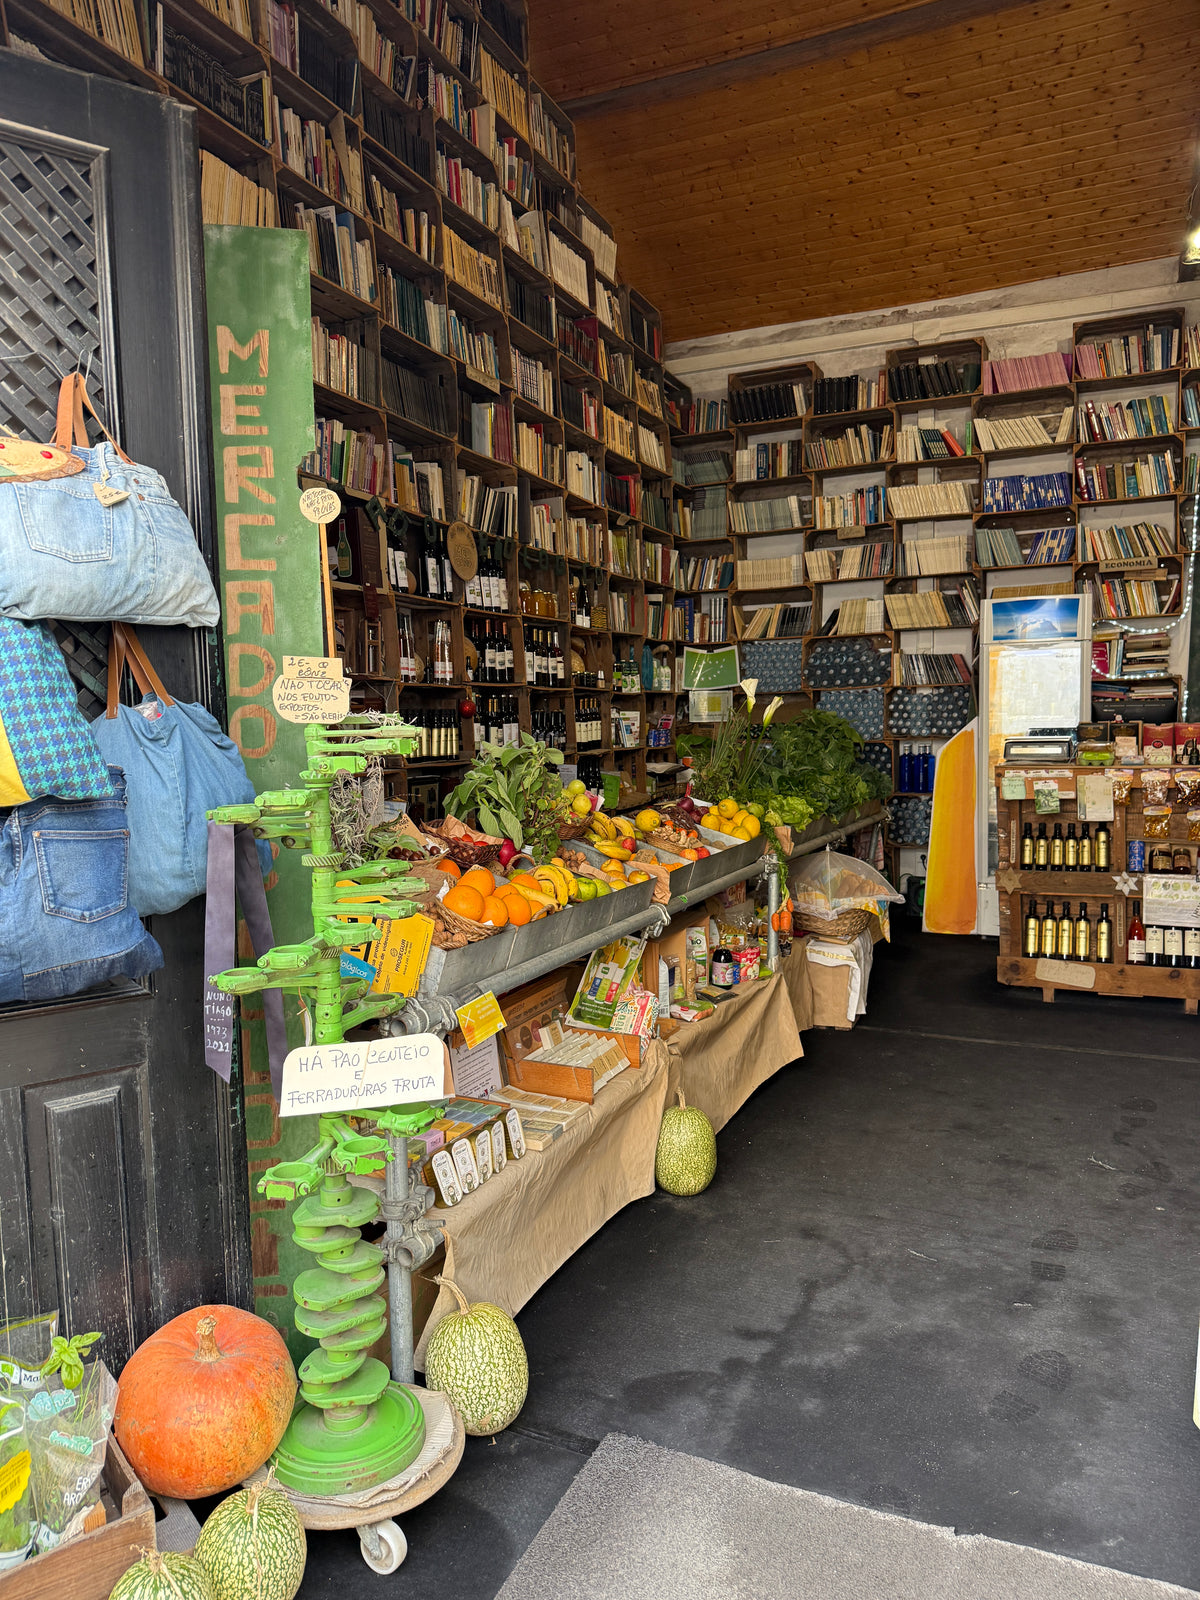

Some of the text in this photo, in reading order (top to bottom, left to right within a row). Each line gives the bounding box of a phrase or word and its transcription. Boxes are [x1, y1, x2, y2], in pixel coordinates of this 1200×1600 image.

[214, 324, 277, 759] MERCADO
[1104, 559, 1153, 569] ECONOMIA
[277, 692, 298, 702] NOS
[395, 939, 407, 973] PROSEGUR
[206, 991, 231, 1001] NUNO
[206, 1024, 228, 1039] 1973
[206, 1039, 230, 1053] 2021
[298, 1051, 323, 1073] HÁ
[354, 1069, 363, 1081] E
[392, 1075, 436, 1094] FRUTA
